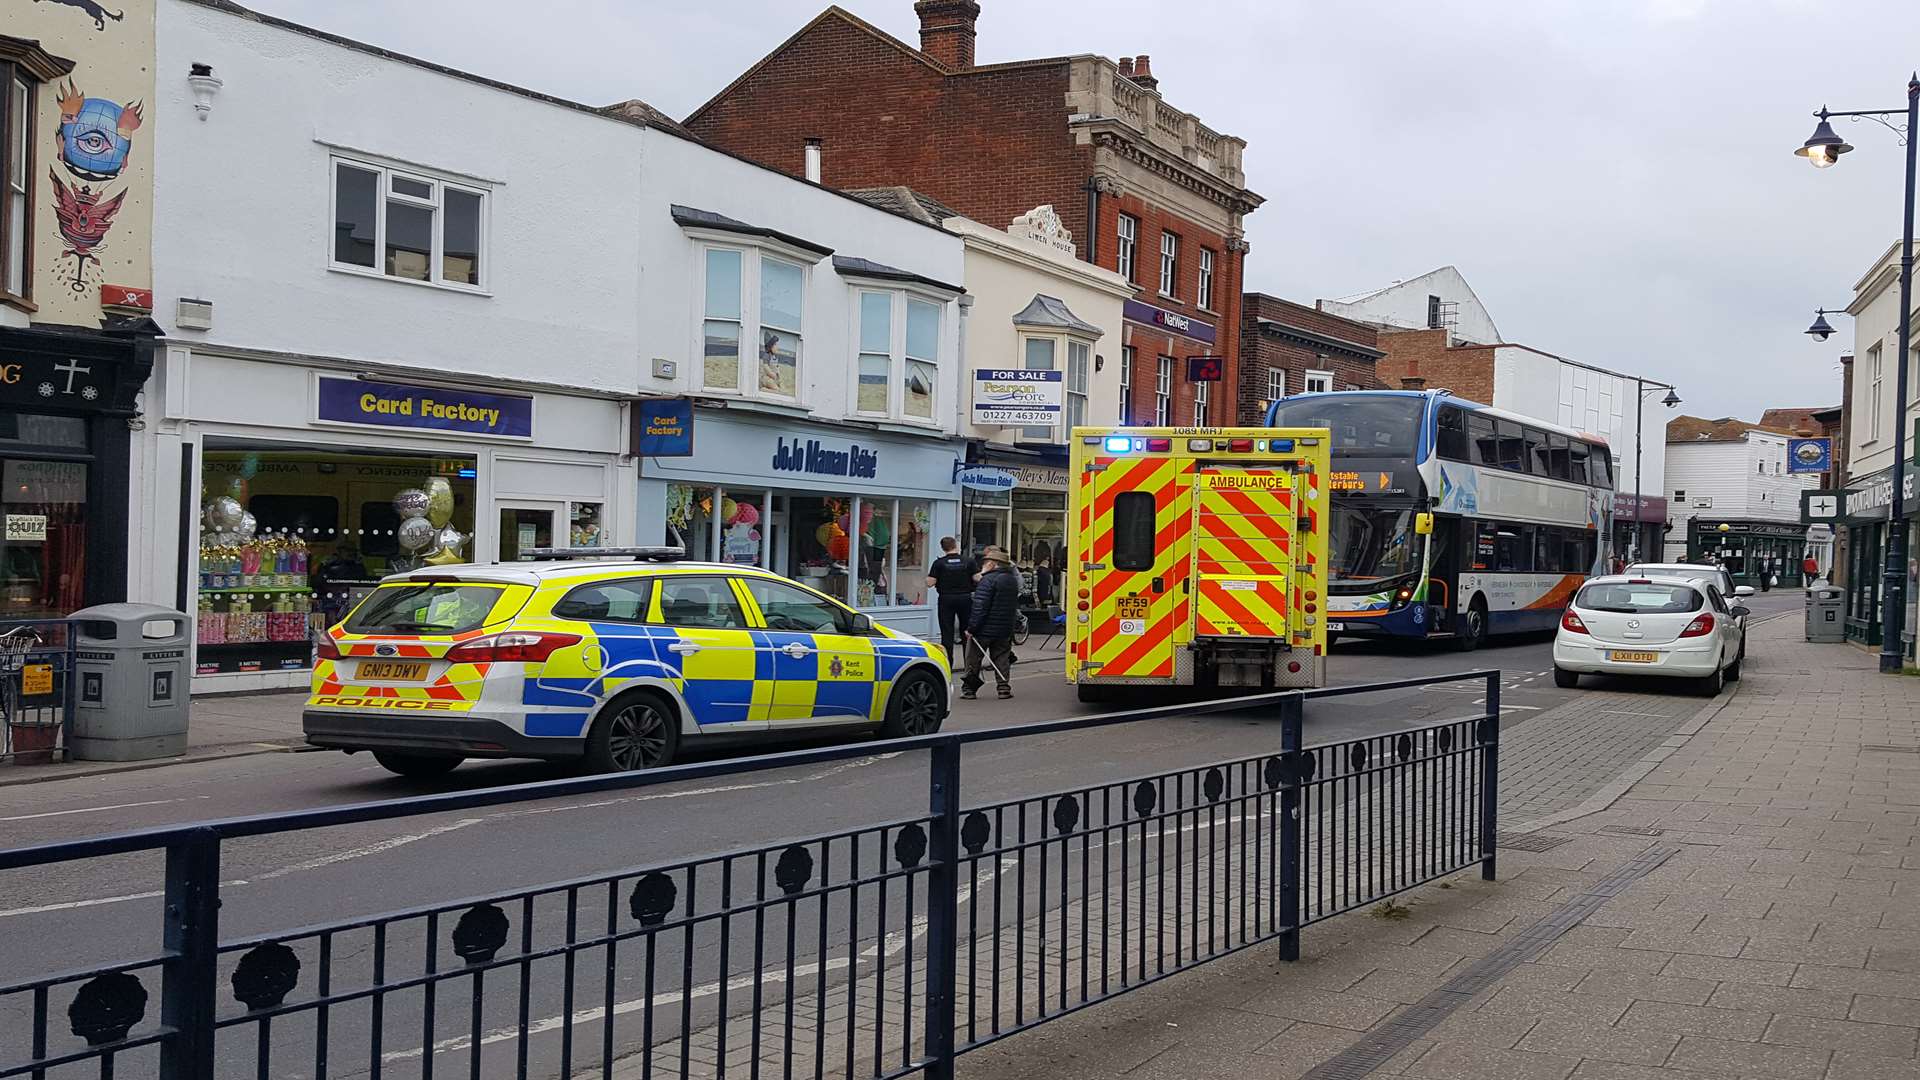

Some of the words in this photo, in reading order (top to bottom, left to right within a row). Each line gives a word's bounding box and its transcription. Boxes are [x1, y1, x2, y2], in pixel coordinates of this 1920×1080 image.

[1052, 240, 1072, 253] HOUSE
[1164, 311, 1189, 331] NatWest
[992, 371, 1015, 380] FOR
[1018, 371, 1047, 381] SALE
[983, 382, 1036, 393] Pearson
[1012, 390, 1046, 401] Gore
[360, 393, 412, 415] Card
[421, 399, 500, 427] Factory
[653, 416, 677, 425] Card
[983, 411, 1012, 420] 01227
[1015, 412, 1053, 421] 463709
[646, 426, 682, 436] Factory
[1173, 427, 1197, 435] 1089
[773, 436, 804, 472] JoJo
[805, 440, 848, 476] Maman
[849, 445, 878, 479] Bébé
[961, 473, 976, 484] JoJo
[976, 474, 997, 486] Maman
[1209, 476, 1283, 488] AMBULANCE
[8, 521, 45, 535] QUIZ
[1117, 598, 1148, 607] RF59
[1121, 608, 1144, 618] CVC
[362, 663, 392, 678] GN13
[392, 664, 421, 679] DWV
[846, 669, 864, 677] Police
[317, 697, 453, 710] POLICE
